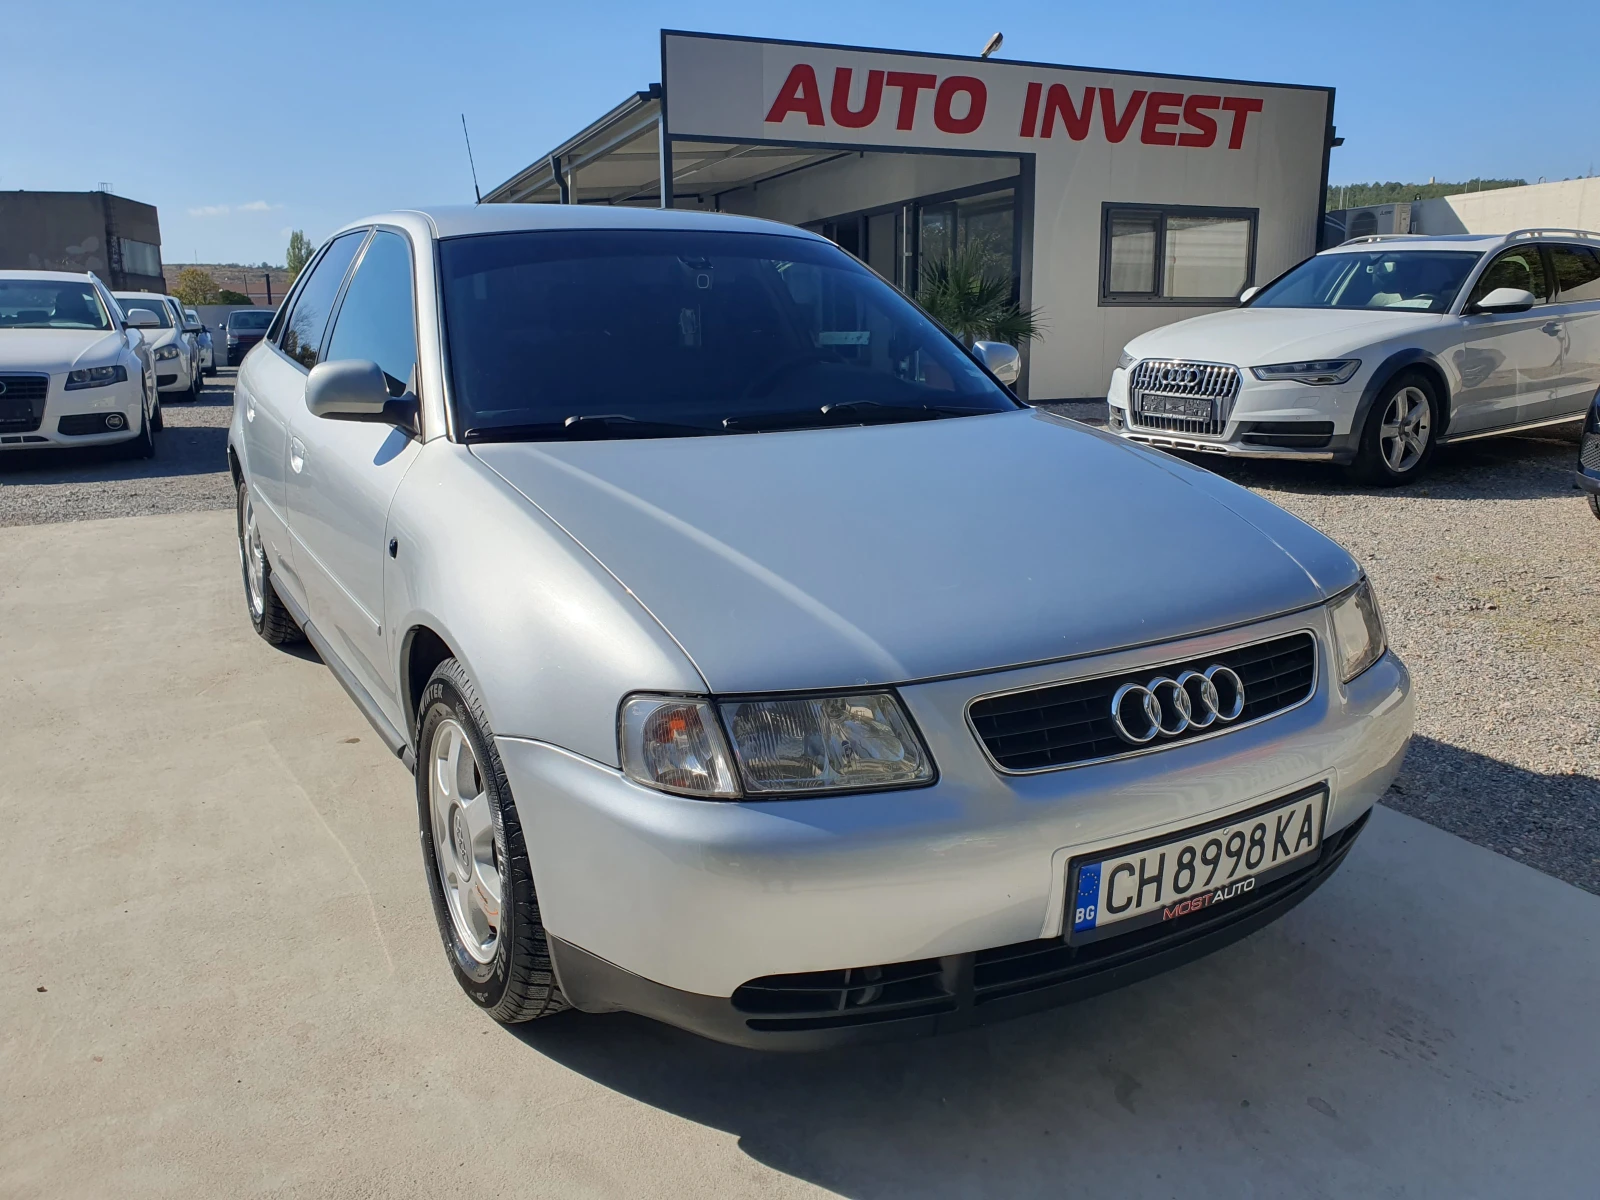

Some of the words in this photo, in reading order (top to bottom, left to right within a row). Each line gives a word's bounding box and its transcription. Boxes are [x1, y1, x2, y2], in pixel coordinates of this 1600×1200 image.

[764, 64, 987, 134] AUTO
[1019, 82, 1264, 150] INVEST
[1075, 905, 1095, 924] BG
